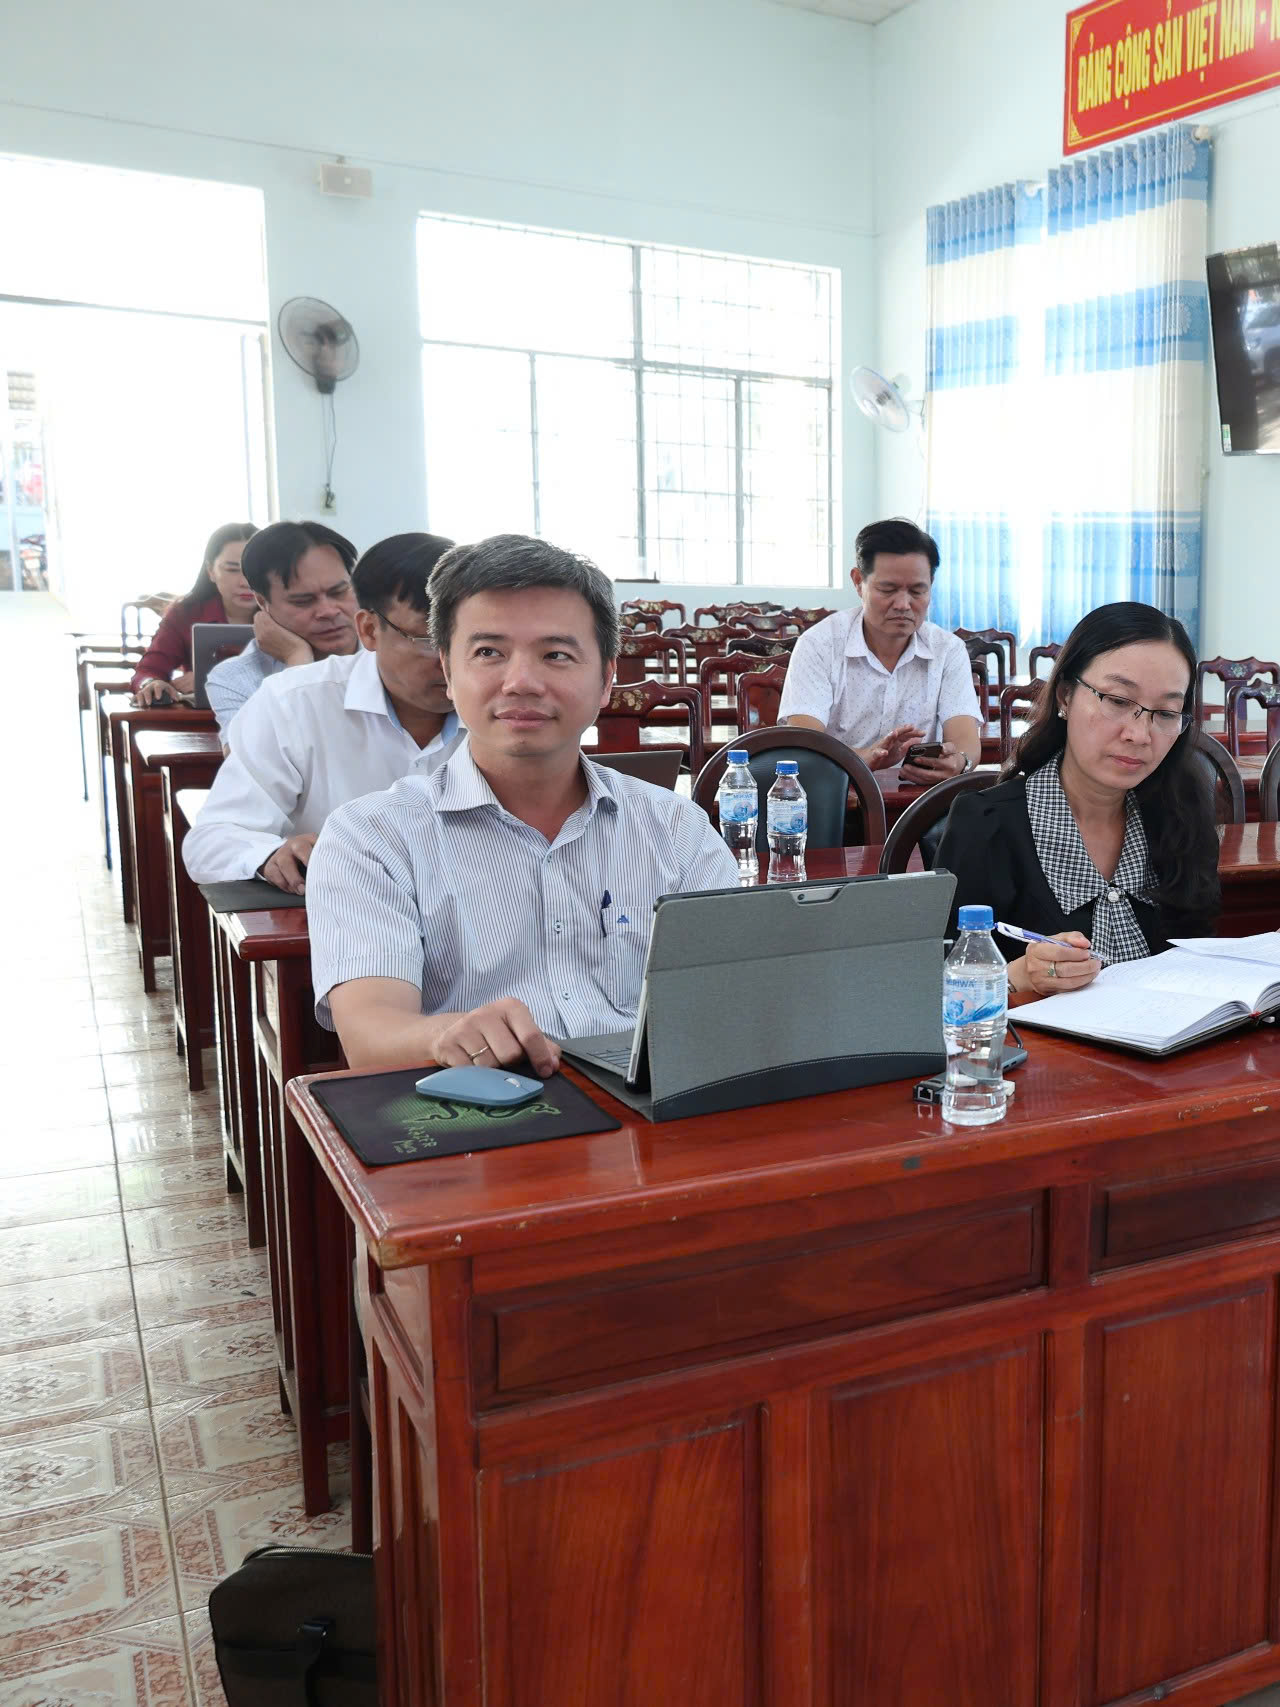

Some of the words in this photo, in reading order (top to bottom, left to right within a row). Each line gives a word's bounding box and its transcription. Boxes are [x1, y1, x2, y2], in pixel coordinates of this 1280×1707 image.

[1077, 32, 1113, 113] ĐẢNG
[1114, 23, 1151, 110] CỘNG
[1153, 0, 1184, 86] SẢN
[1186, 0, 1218, 83] VIỆT
[1218, 0, 1256, 62] NAM
